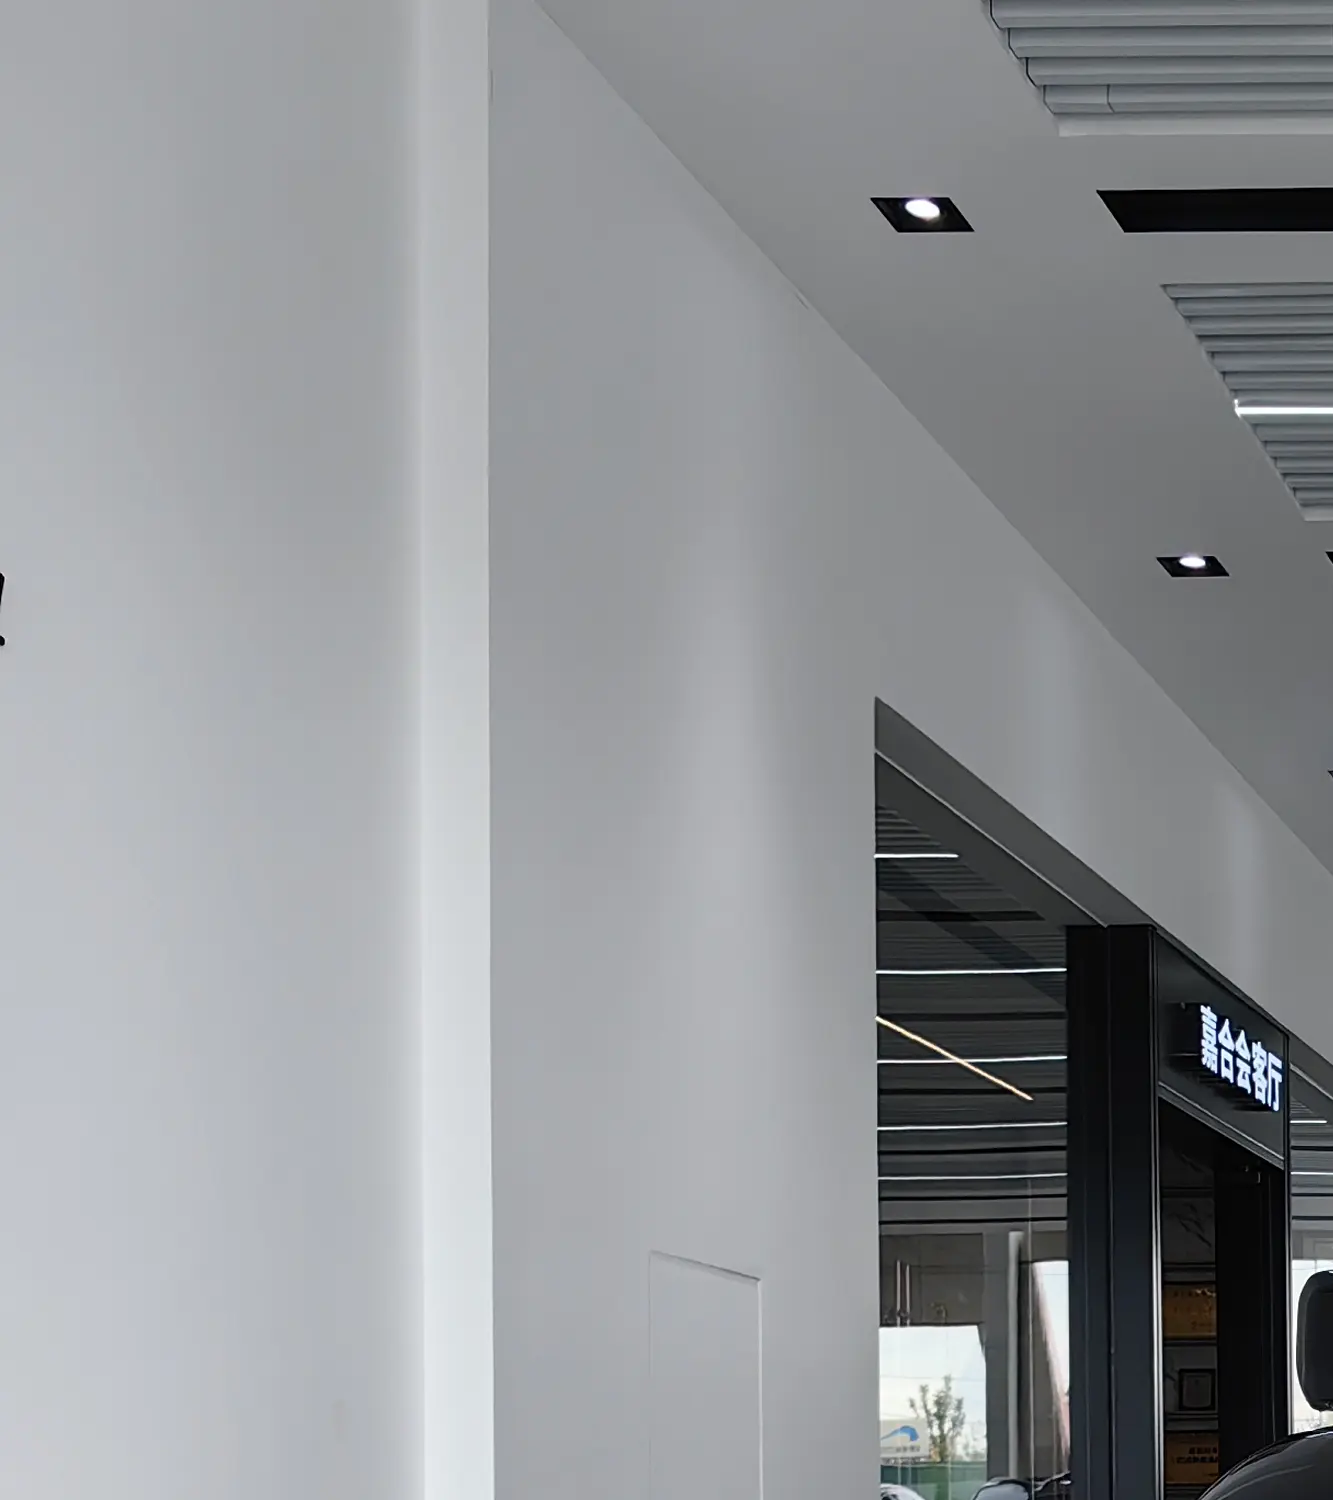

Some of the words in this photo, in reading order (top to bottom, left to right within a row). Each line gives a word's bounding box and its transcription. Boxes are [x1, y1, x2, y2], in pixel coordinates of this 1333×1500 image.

[1200, 1004, 1283, 1112] 嘉合会客厅
